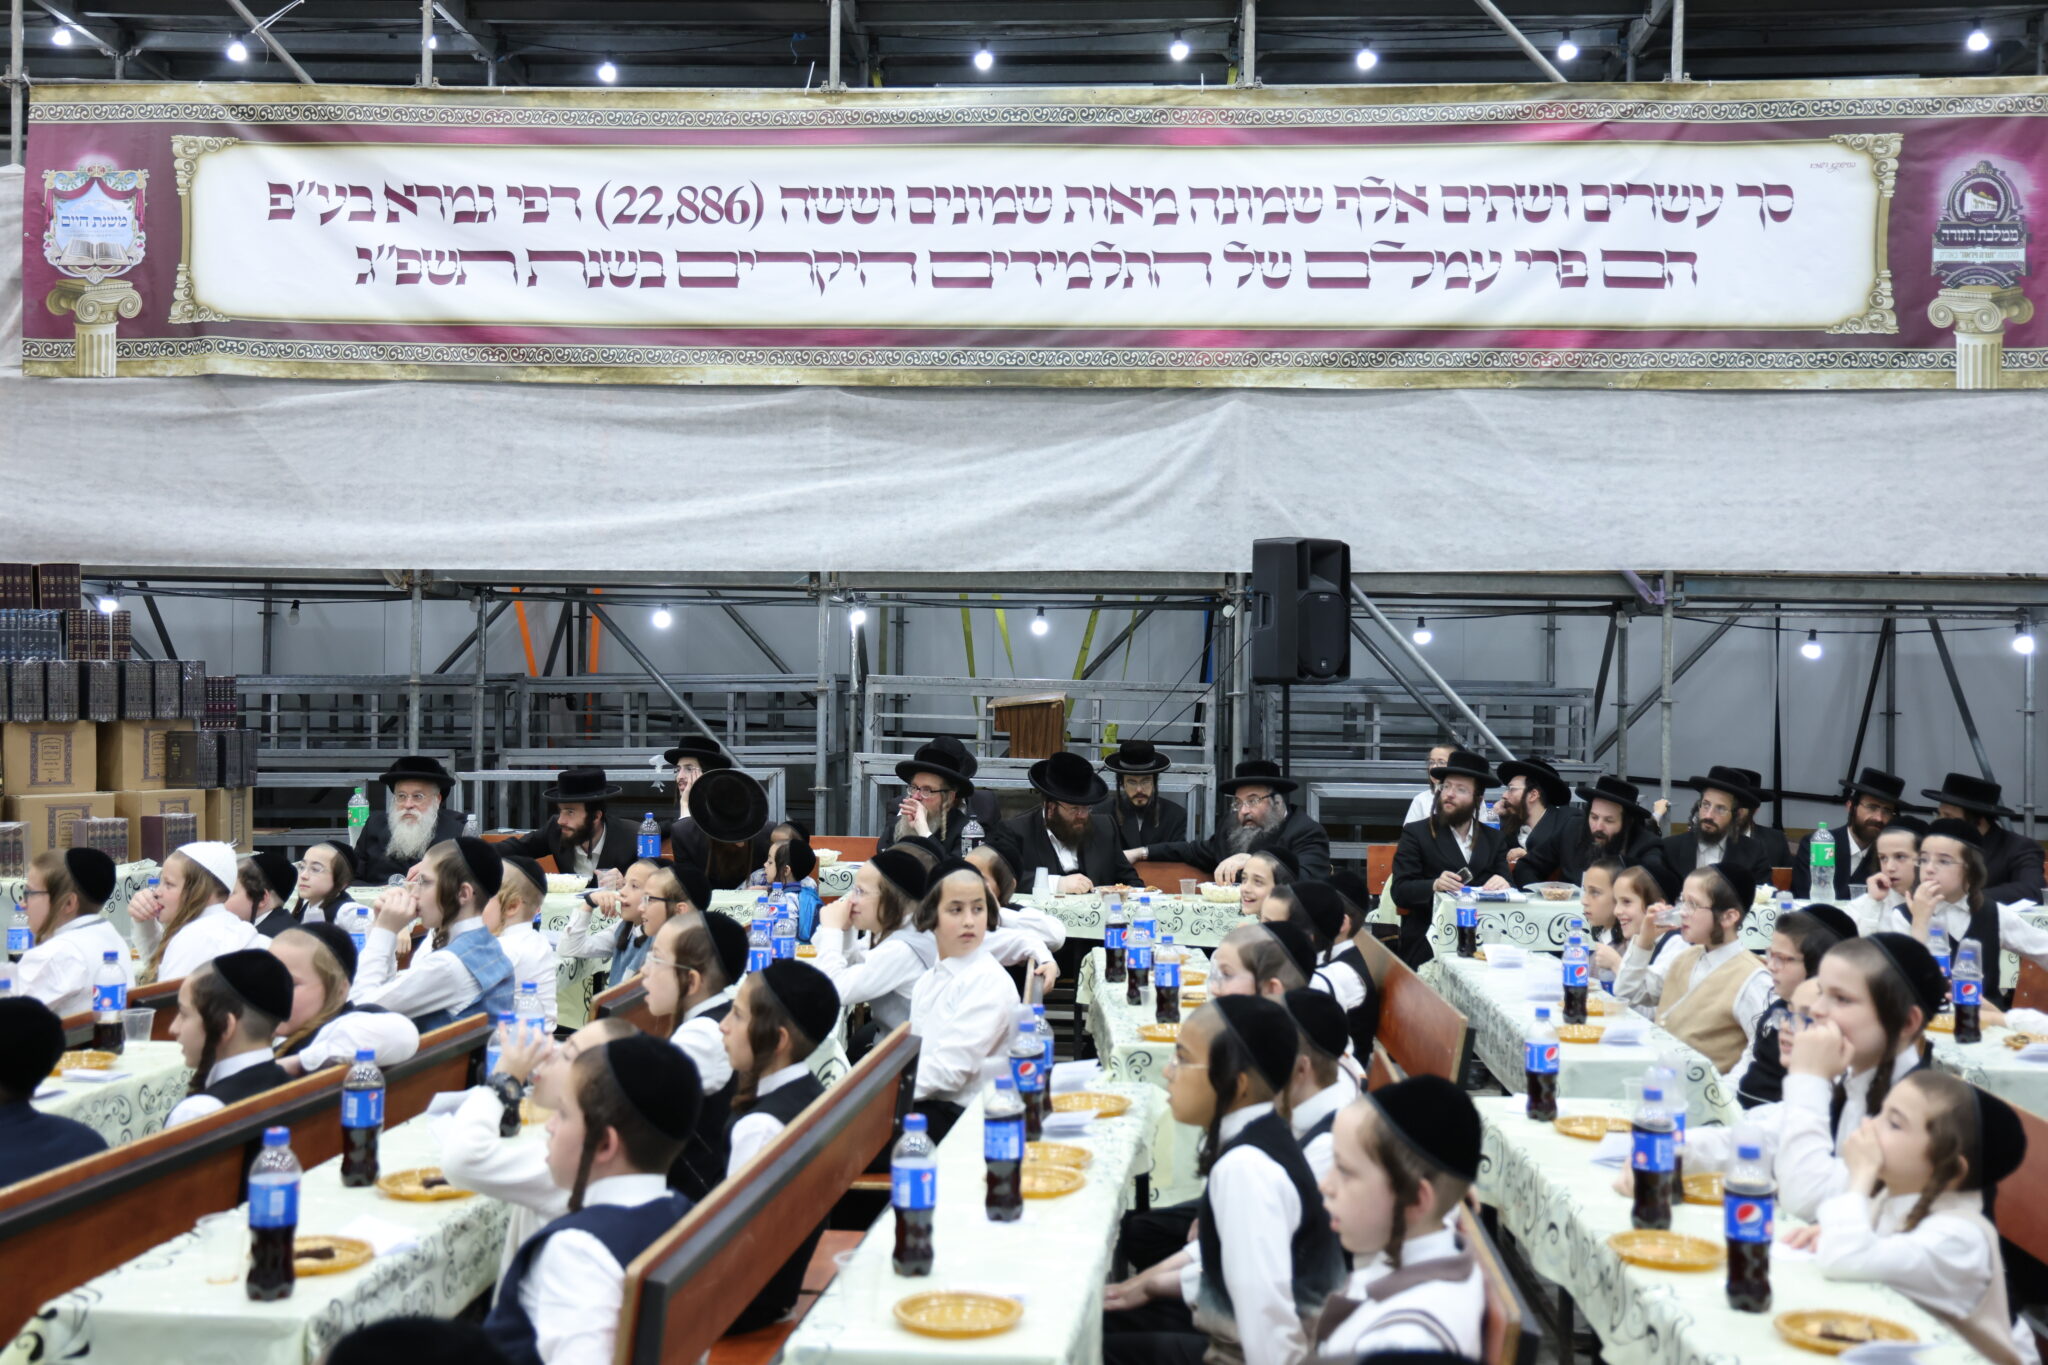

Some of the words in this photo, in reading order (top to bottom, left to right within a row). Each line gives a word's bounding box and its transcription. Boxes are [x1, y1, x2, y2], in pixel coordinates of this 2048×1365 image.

[61, 215, 89, 228] חיים
[92, 215, 128, 228] משנת
[384, 179, 496, 225] גמרא
[506, 184, 582, 224] דפי
[595, 179, 764, 231] (22,886)
[779, 185, 896, 225] וששה
[907, 185, 1052, 226] שמונים
[1064, 182, 1180, 226] מאות
[1188, 185, 1323, 226] שמונה
[1334, 176, 1429, 231] אלף
[1440, 182, 1569, 223] ושתים
[1580, 182, 1724, 229] עשרים
[1736, 183, 1794, 231] סך
[1941, 229, 1976, 242] התורה
[1977, 224, 2019, 242] ממלכת
[527, 248, 667, 289] בשנת
[675, 249, 917, 296] היקרים
[928, 240, 1212, 291] התלמידים
[1223, 240, 1292, 290] של
[1304, 240, 1502, 294] עמלם
[1514, 248, 1589, 289] פרי
[1600, 248, 1698, 289] הם
